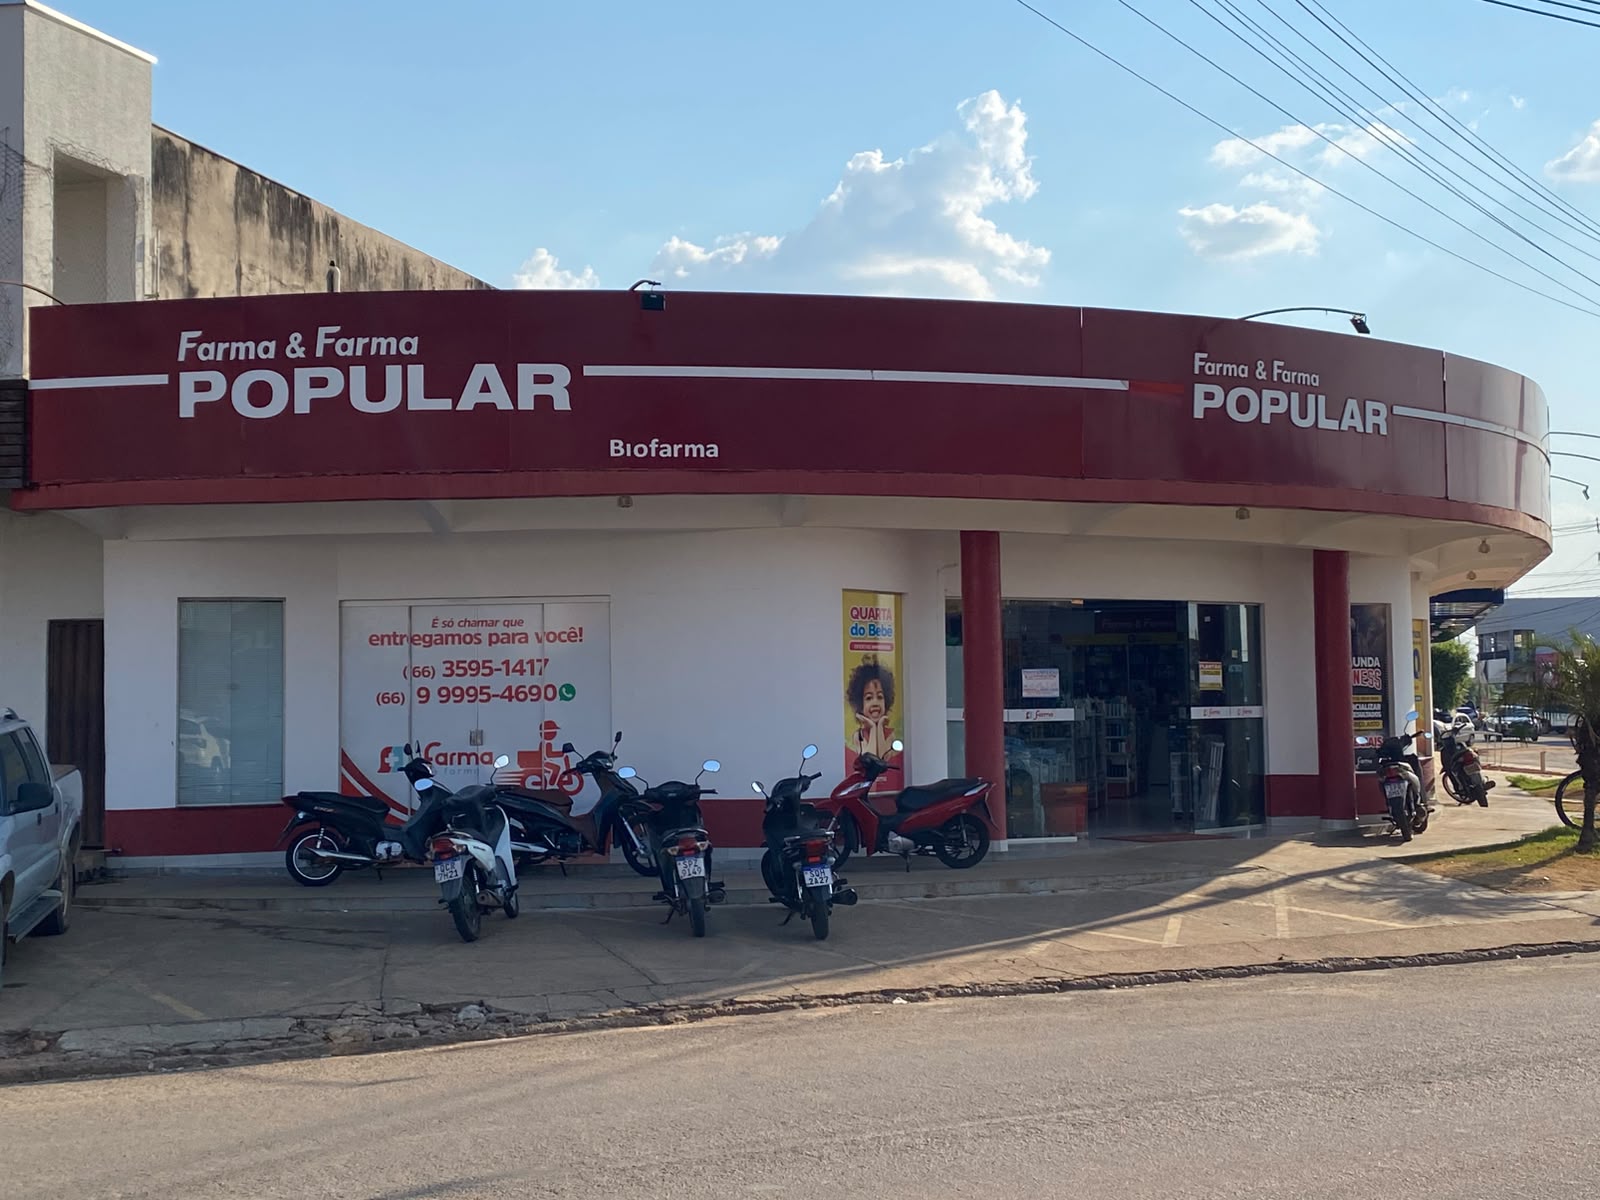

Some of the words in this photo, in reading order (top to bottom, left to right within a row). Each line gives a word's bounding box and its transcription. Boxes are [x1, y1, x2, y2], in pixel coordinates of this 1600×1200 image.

[177, 330, 276, 361] Farma
[284, 332, 306, 358] &
[315, 325, 419, 357] Farma
[1194, 352, 1249, 378] Farma
[1255, 360, 1267, 380] &
[1272, 360, 1320, 387] Farma
[179, 362, 572, 419] POPULAR
[1193, 383, 1388, 436] POPULAR
[609, 438, 720, 459] Biofarma
[431, 616, 440, 628] É
[442, 617, 454, 628] só
[457, 618, 499, 627] chamar
[502, 618, 524, 630] que
[850, 606, 893, 621] QUARTA
[368, 631, 482, 648] entregamos
[487, 631, 529, 647] para
[534, 627, 584, 644] você!
[850, 622, 866, 637] do
[868, 623, 893, 638] Bebê
[402, 665, 436, 680] (66)
[442, 658, 549, 678] 3595-1417
[1352, 656, 1381, 668] UNDA
[1352, 668, 1382, 690] NESS
[375, 692, 406, 706] (66)
[416, 686, 430, 704] 9
[437, 684, 558, 704] 9995-4690
